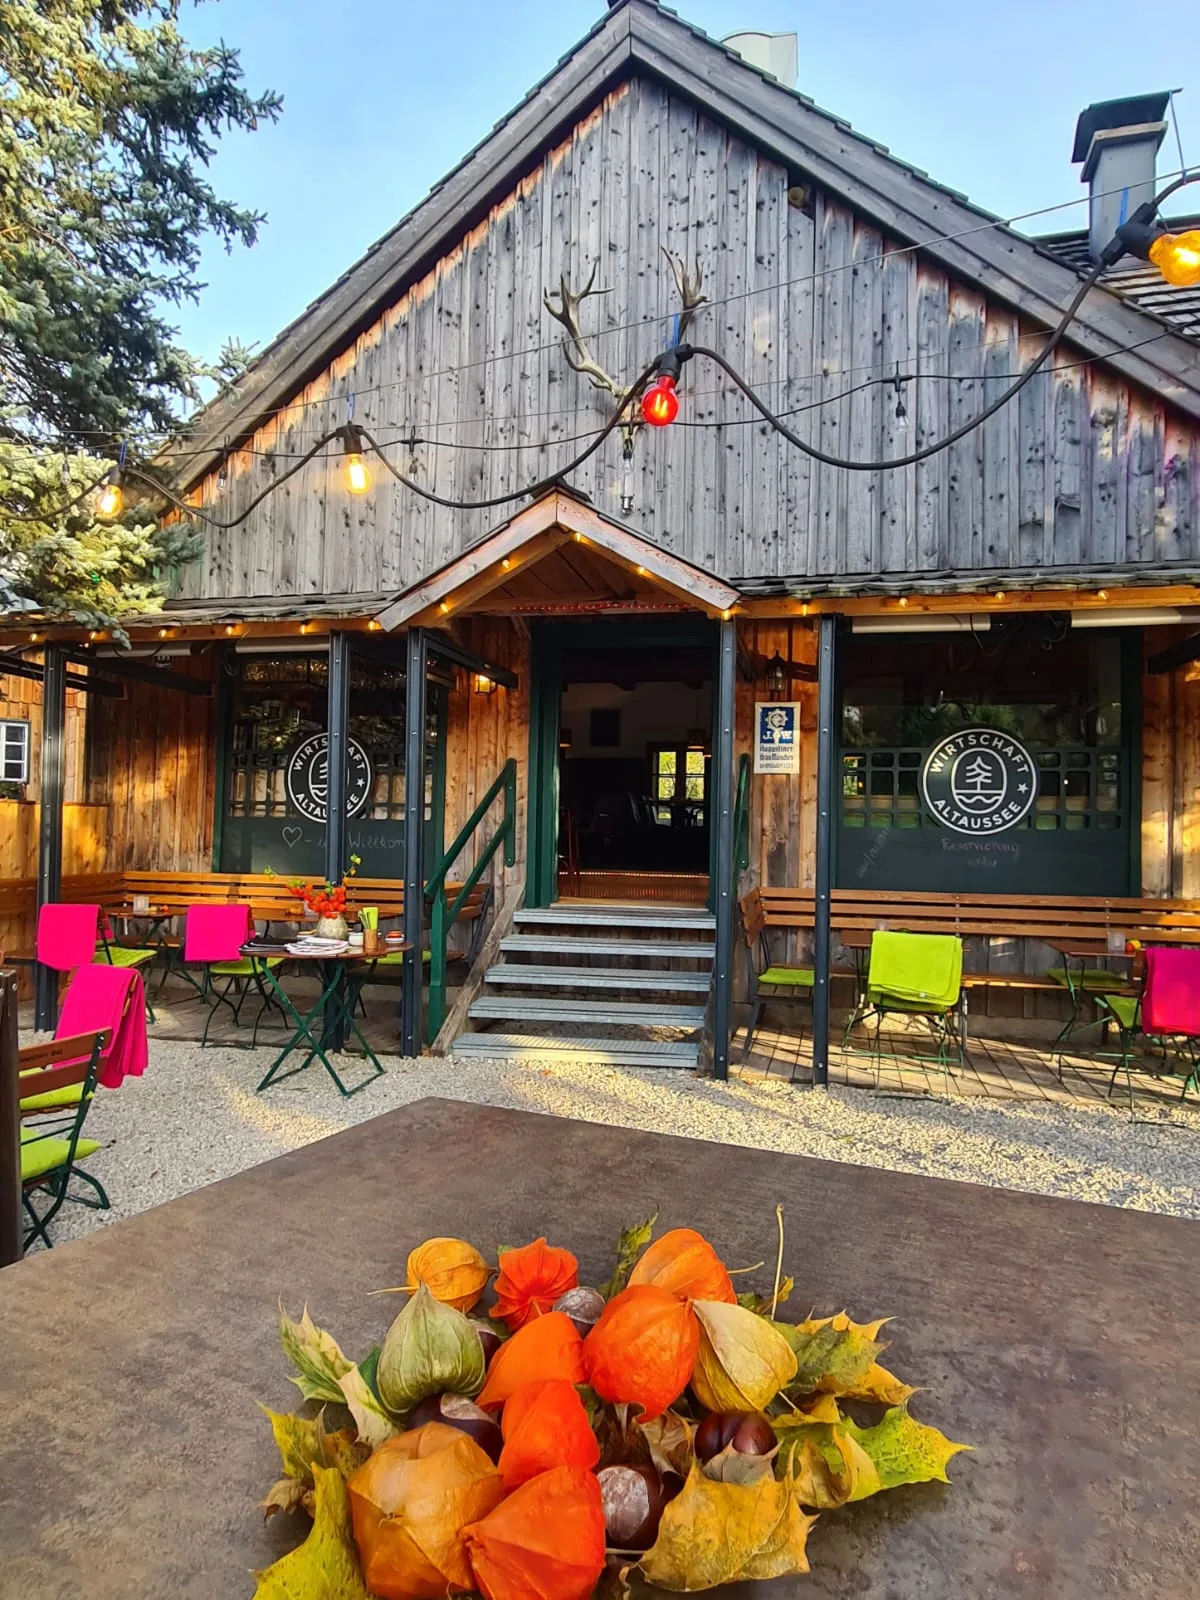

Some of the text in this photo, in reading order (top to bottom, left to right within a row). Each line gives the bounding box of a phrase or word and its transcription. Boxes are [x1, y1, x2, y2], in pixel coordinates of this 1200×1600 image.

[293, 737, 365, 771] WIRTSAFT
[930, 734, 1029, 773] WIRTSCHAFT
[296, 793, 360, 817] ALTAUEE
[934, 799, 1021, 829] ALTAUSSEE
